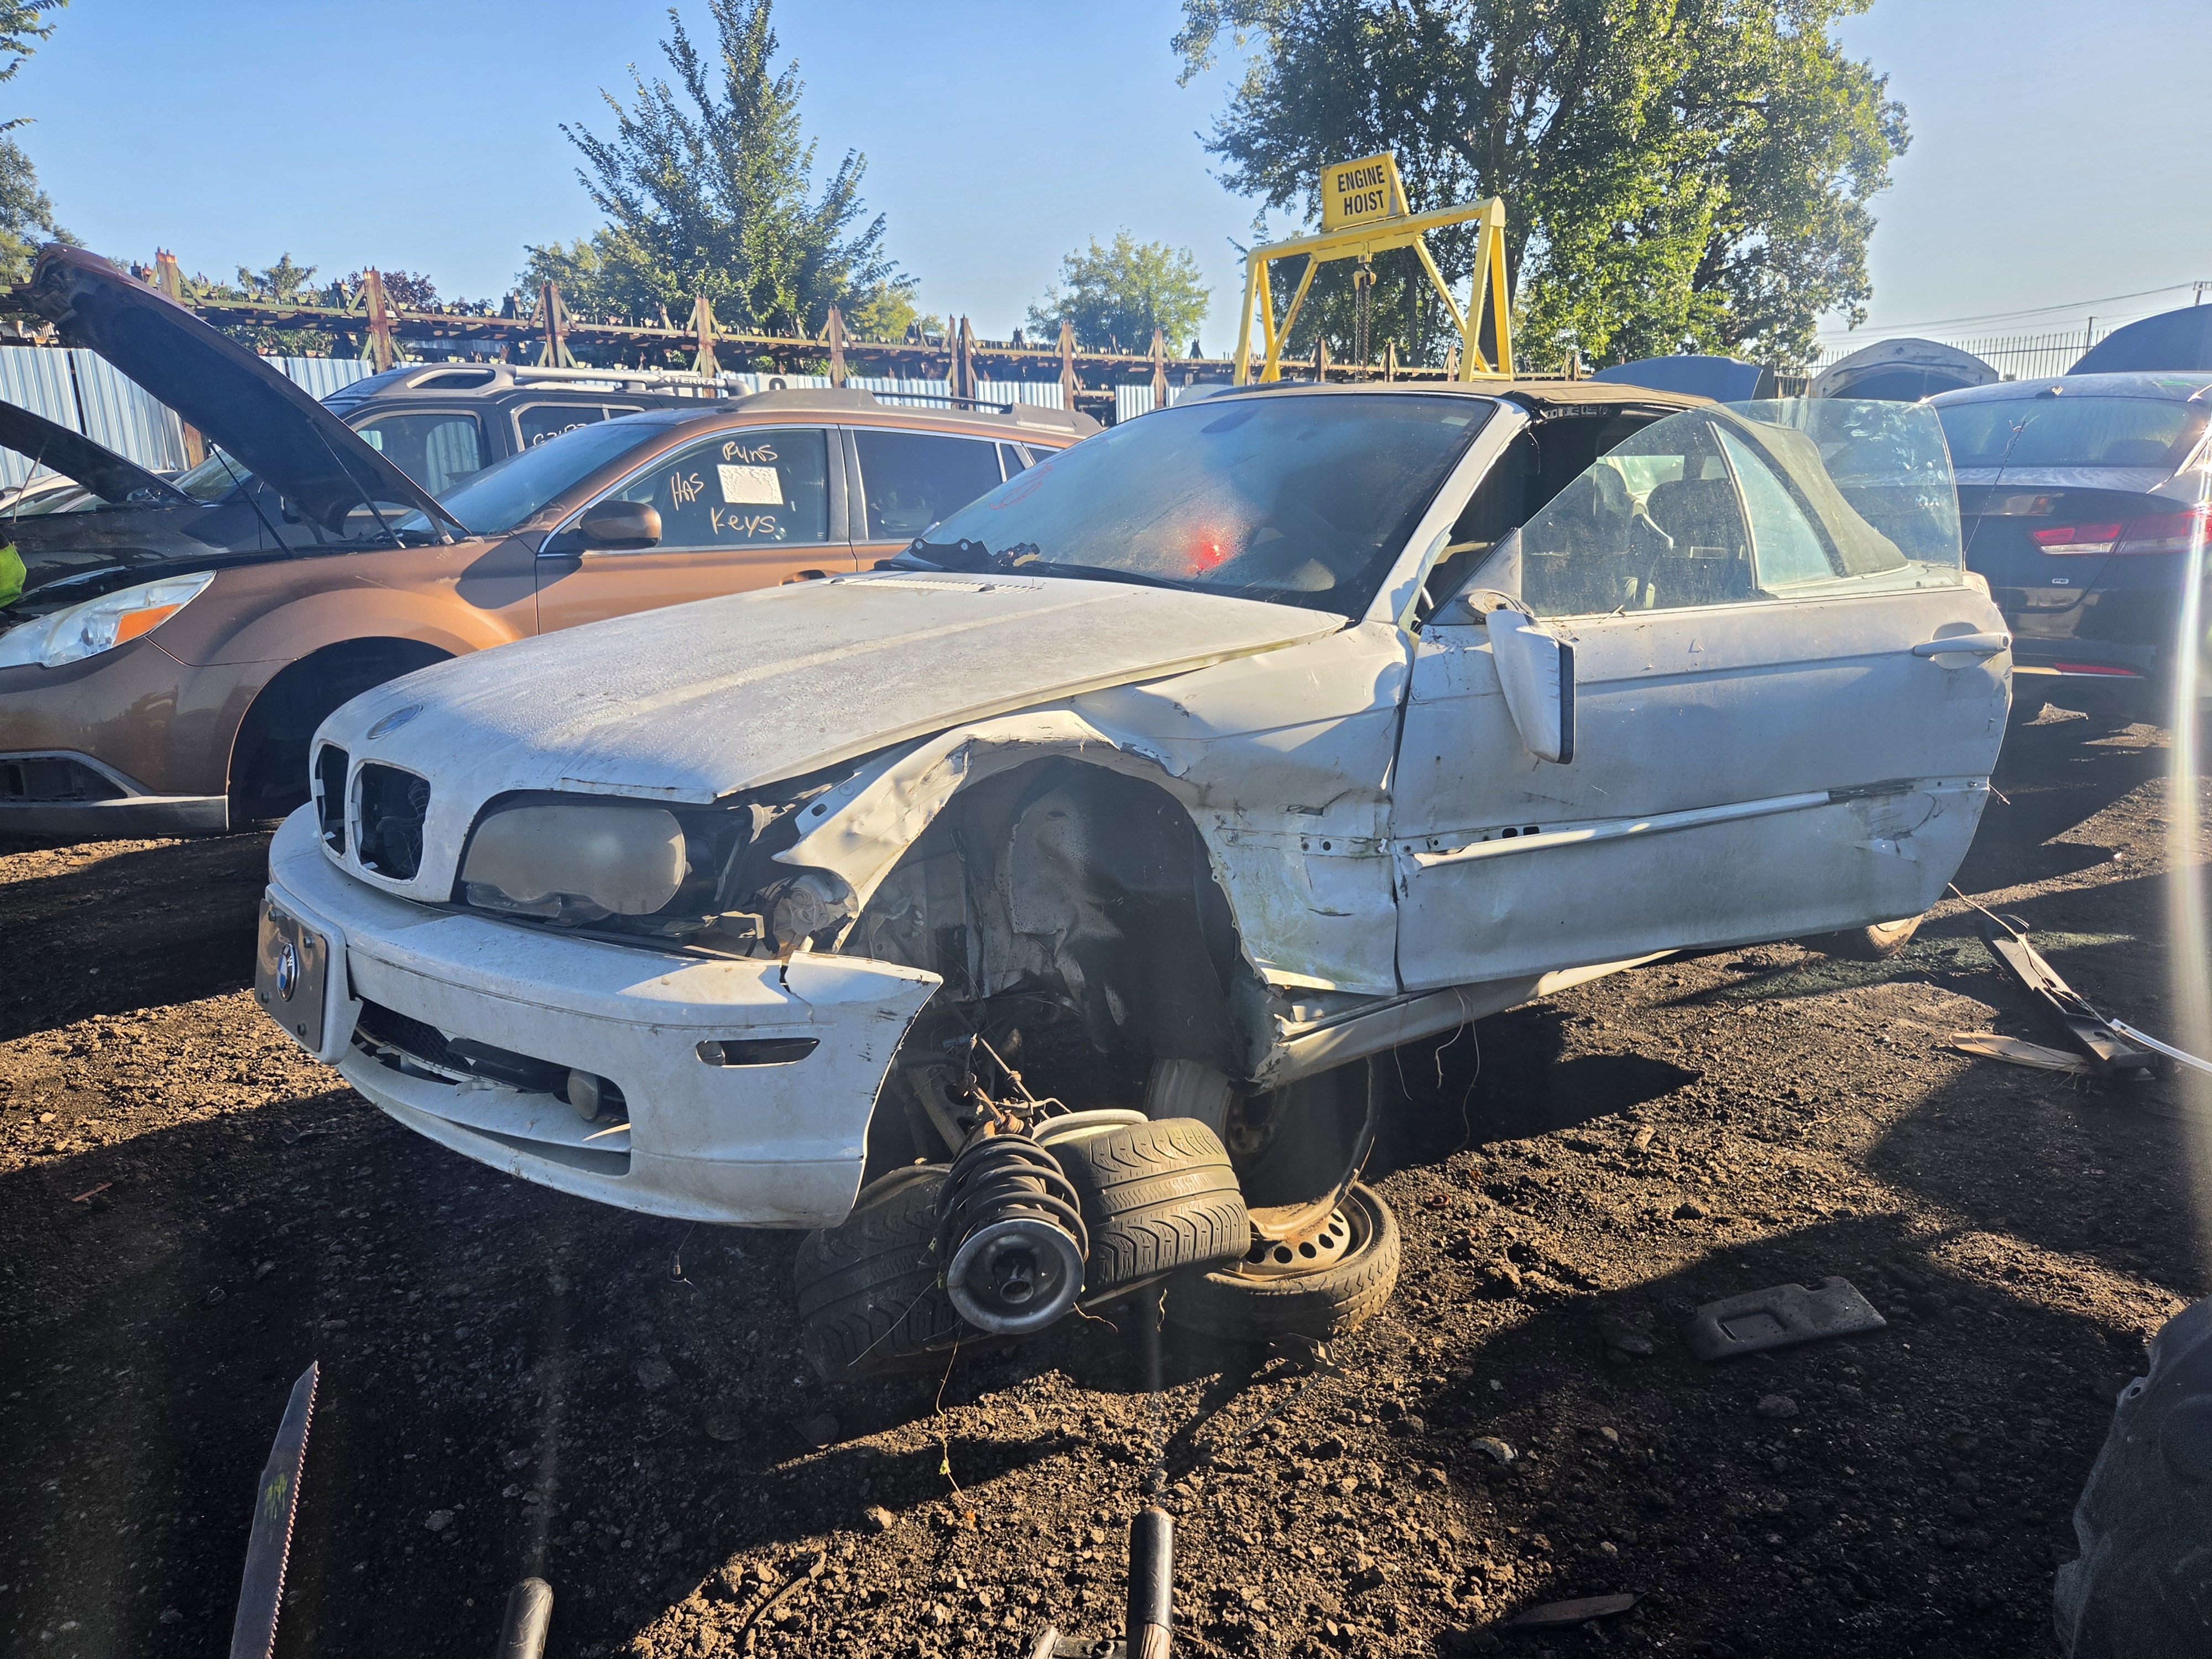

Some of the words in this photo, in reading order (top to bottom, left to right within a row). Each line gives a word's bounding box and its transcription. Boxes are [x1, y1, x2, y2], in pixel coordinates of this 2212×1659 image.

[1337, 165, 1385, 193] ENGINE
[1344, 190, 1384, 216] HOIST
[656, 375, 716, 386] XTERRA
